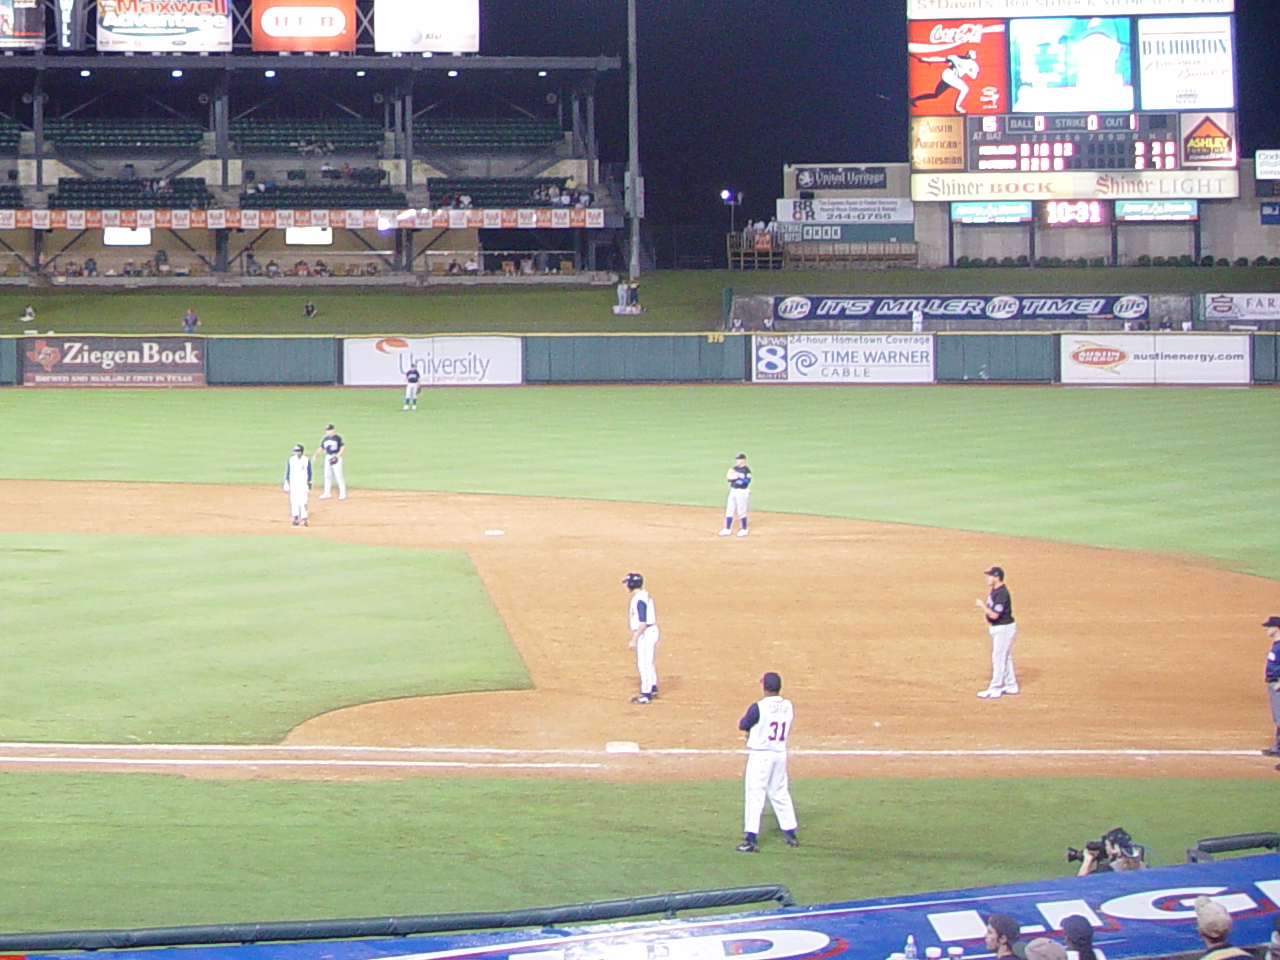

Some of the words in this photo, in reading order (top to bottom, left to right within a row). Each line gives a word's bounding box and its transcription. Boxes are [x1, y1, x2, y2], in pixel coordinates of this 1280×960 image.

[1010, 119, 1033, 128] BALL
[1054, 118, 1086, 128] STRIKE
[1106, 116, 1124, 127] OUT
[1187, 137, 1229, 147] ASHLEY
[925, 176, 983, 197] Shiner
[990, 183, 1052, 193] BOCK
[1094, 174, 1154, 195] Shiner
[1159, 178, 1227, 194] LIGHT
[1046, 201, 1101, 224] 10:31
[816, 299, 875, 316] IT'S
[876, 299, 986, 315] MILLER
[1246, 298, 1280, 308] FAR
[756, 335, 787, 346] NEWS
[789, 336, 828, 344] 24-hour
[831, 336, 882, 344] Hometown
[885, 336, 930, 345] Coverage
[756, 345, 787, 373] 8
[822, 350, 859, 363] TIME
[863, 350, 931, 363] WARNER
[1132, 351, 1245, 362] austinenergy.com
[399, 352, 490, 381] University
[821, 367, 870, 378] CABLE
[767, 721, 787, 742] 31
